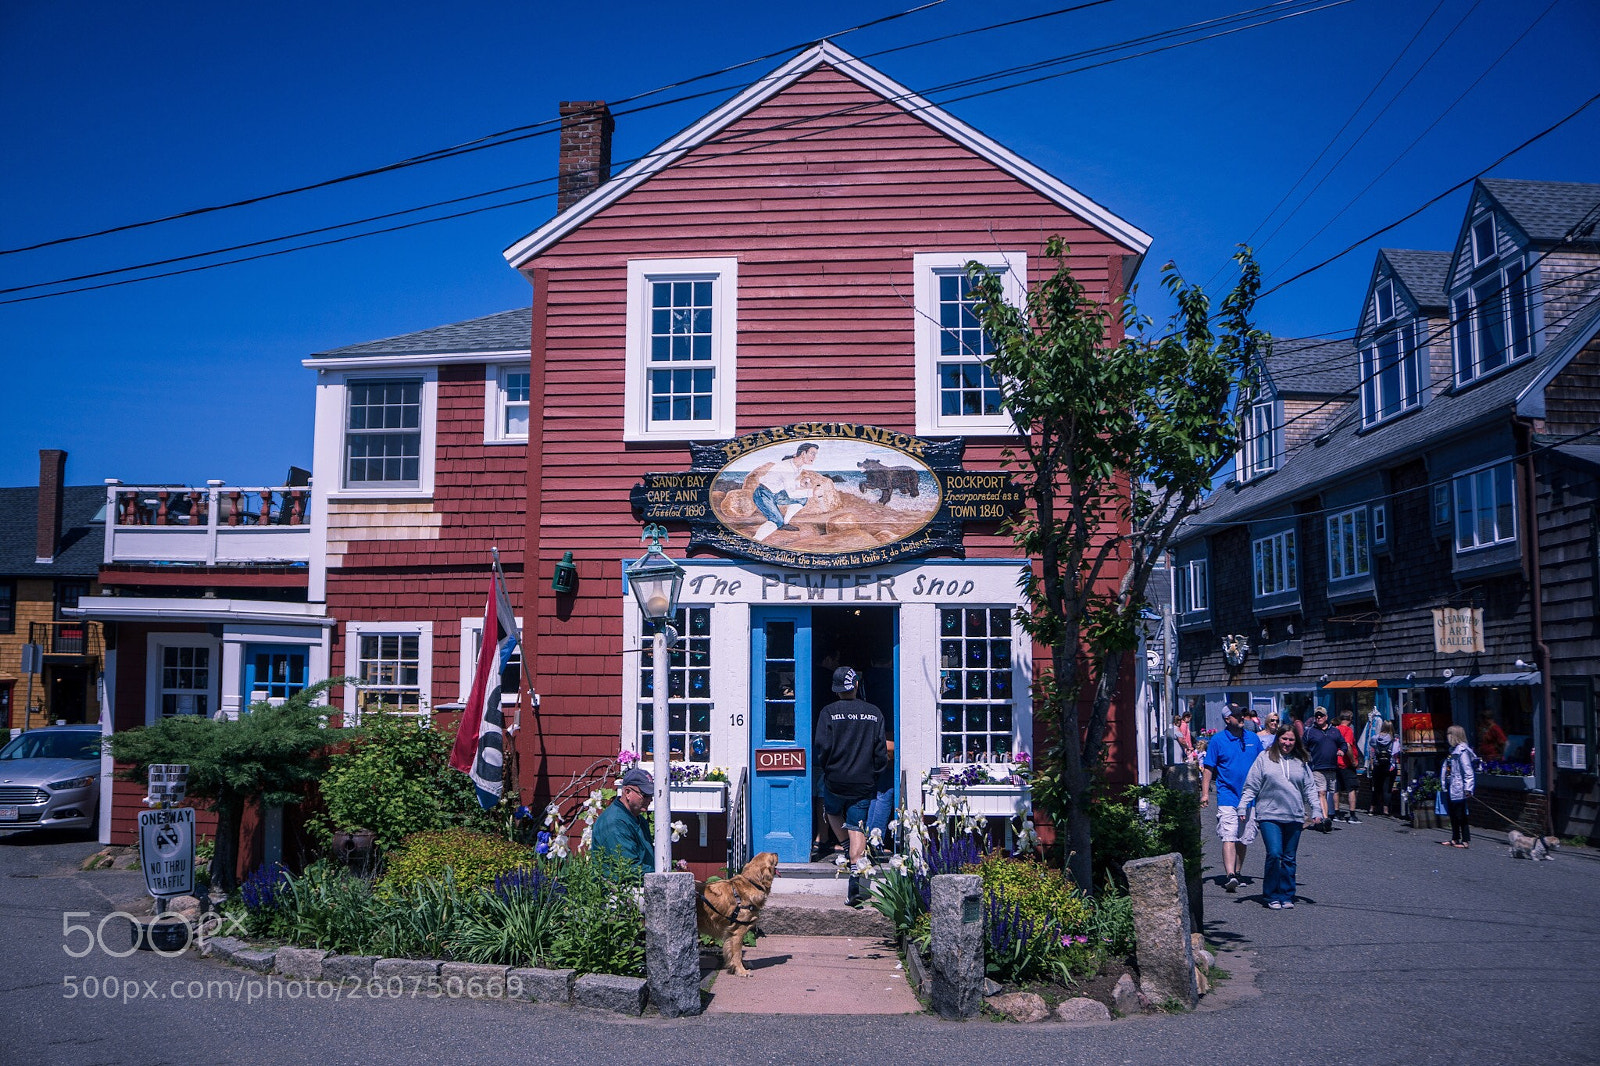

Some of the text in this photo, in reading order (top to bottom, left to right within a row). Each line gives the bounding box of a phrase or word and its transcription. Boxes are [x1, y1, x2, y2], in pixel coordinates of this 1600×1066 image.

[721, 423, 928, 460] BEAR SKIN NECK
[651, 475, 707, 488] SANDY BAY
[946, 475, 1007, 489] ROCKPORT
[647, 490, 698, 502] CAPE ANN
[944, 489, 1020, 505] Incorporated as a
[684, 505, 706, 517] 1690
[948, 504, 1005, 518] TOWN 1840
[889, 547, 900, 558] do
[689, 573, 976, 601] The PEWTER Shop
[1449, 627, 1468, 635] ART
[1440, 637, 1478, 646] GALLERY
[729, 714, 744, 726] 16
[860, 713, 878, 722] EARTH
[760, 752, 802, 767] OPEN
[142, 810, 192, 826] ONE WAY
[150, 859, 186, 875] NO THRU
[153, 874, 185, 889] TRAFFIC
